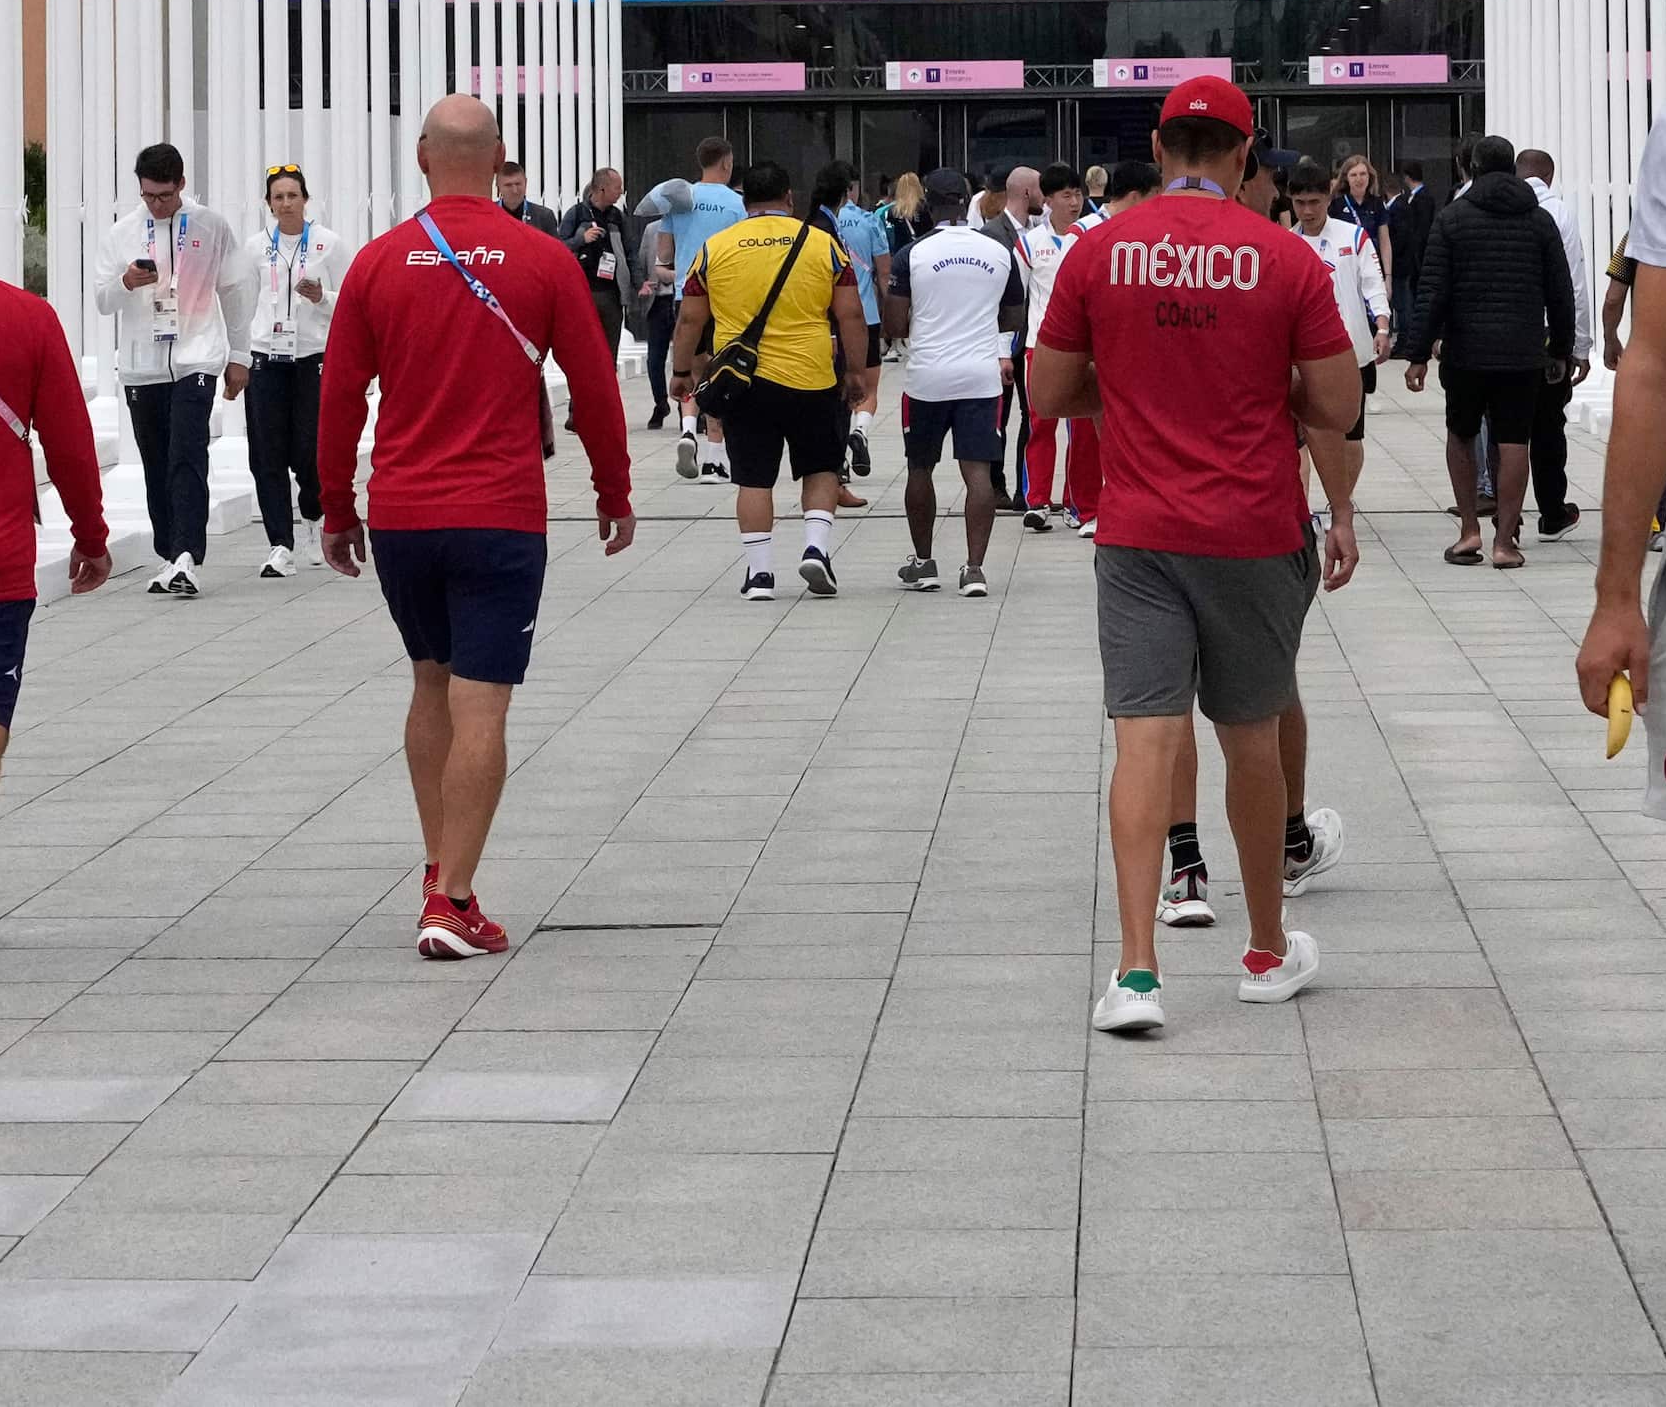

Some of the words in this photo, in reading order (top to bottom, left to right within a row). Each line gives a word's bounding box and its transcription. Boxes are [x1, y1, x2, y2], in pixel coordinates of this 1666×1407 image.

[738, 236, 795, 248] COLOMBI
[932, 257, 995, 274] DOMINICANA
[1110, 233, 1259, 291] MÉXICO
[1155, 300, 1218, 329] COACH
